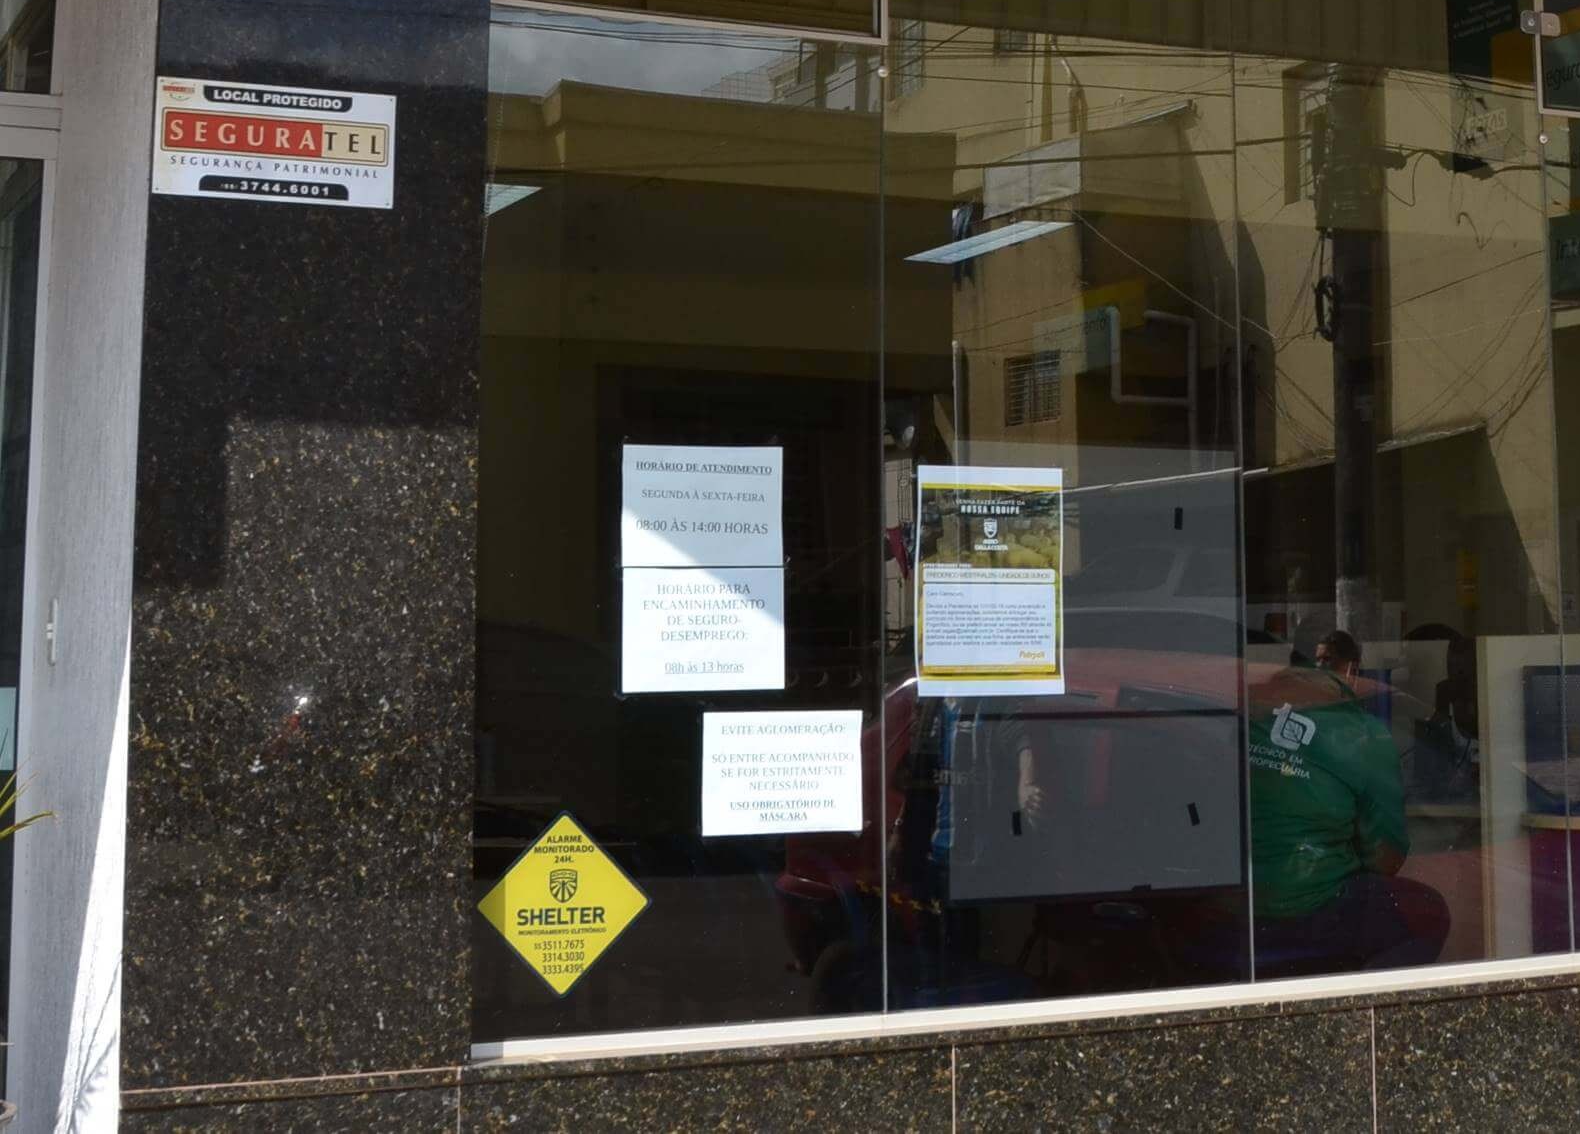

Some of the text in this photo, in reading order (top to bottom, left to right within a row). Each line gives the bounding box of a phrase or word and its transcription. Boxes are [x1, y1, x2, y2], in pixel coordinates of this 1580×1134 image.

[213, 89, 260, 104] LOCAL
[263, 93, 342, 109] PROTEGIDO
[169, 119, 381, 155] SEGURATEL
[170, 155, 379, 180] SEGURANÇA PATRIMONIAL
[239, 181, 329, 196] 3744.6001
[636, 460, 772, 475] HORÁRIO DE ATENDIMENTO
[641, 489, 690, 501] SEGUNDA
[702, 491, 766, 503] SEXTA-FEIRA
[636, 519, 667, 532] 08:00
[691, 521, 721, 534] 14:00
[723, 522, 770, 536] HORAS
[657, 583, 751, 596] HORÁRIO PARA
[643, 599, 766, 611] ENCAMINHAMENTO
[667, 615, 684, 626] DE
[664, 662, 684, 674] 08h
[702, 661, 714, 673] 13
[717, 661, 744, 673] horas
[721, 725, 751, 735] EVITE
[729, 753, 765, 763] ENTRE
[721, 765, 846, 778] SE FOR ESTRITAMENTE
[749, 779, 820, 791] NECESSÁRIO
[730, 798, 836, 811] USO OBRIGATÓRIO DE
[547, 835, 583, 844] ALARME
[534, 845, 594, 854] MONITORADO
[517, 907, 606, 926] SHELTER
[542, 939, 585, 951] 3511.7675
[542, 951, 585, 963] 3314.3030
